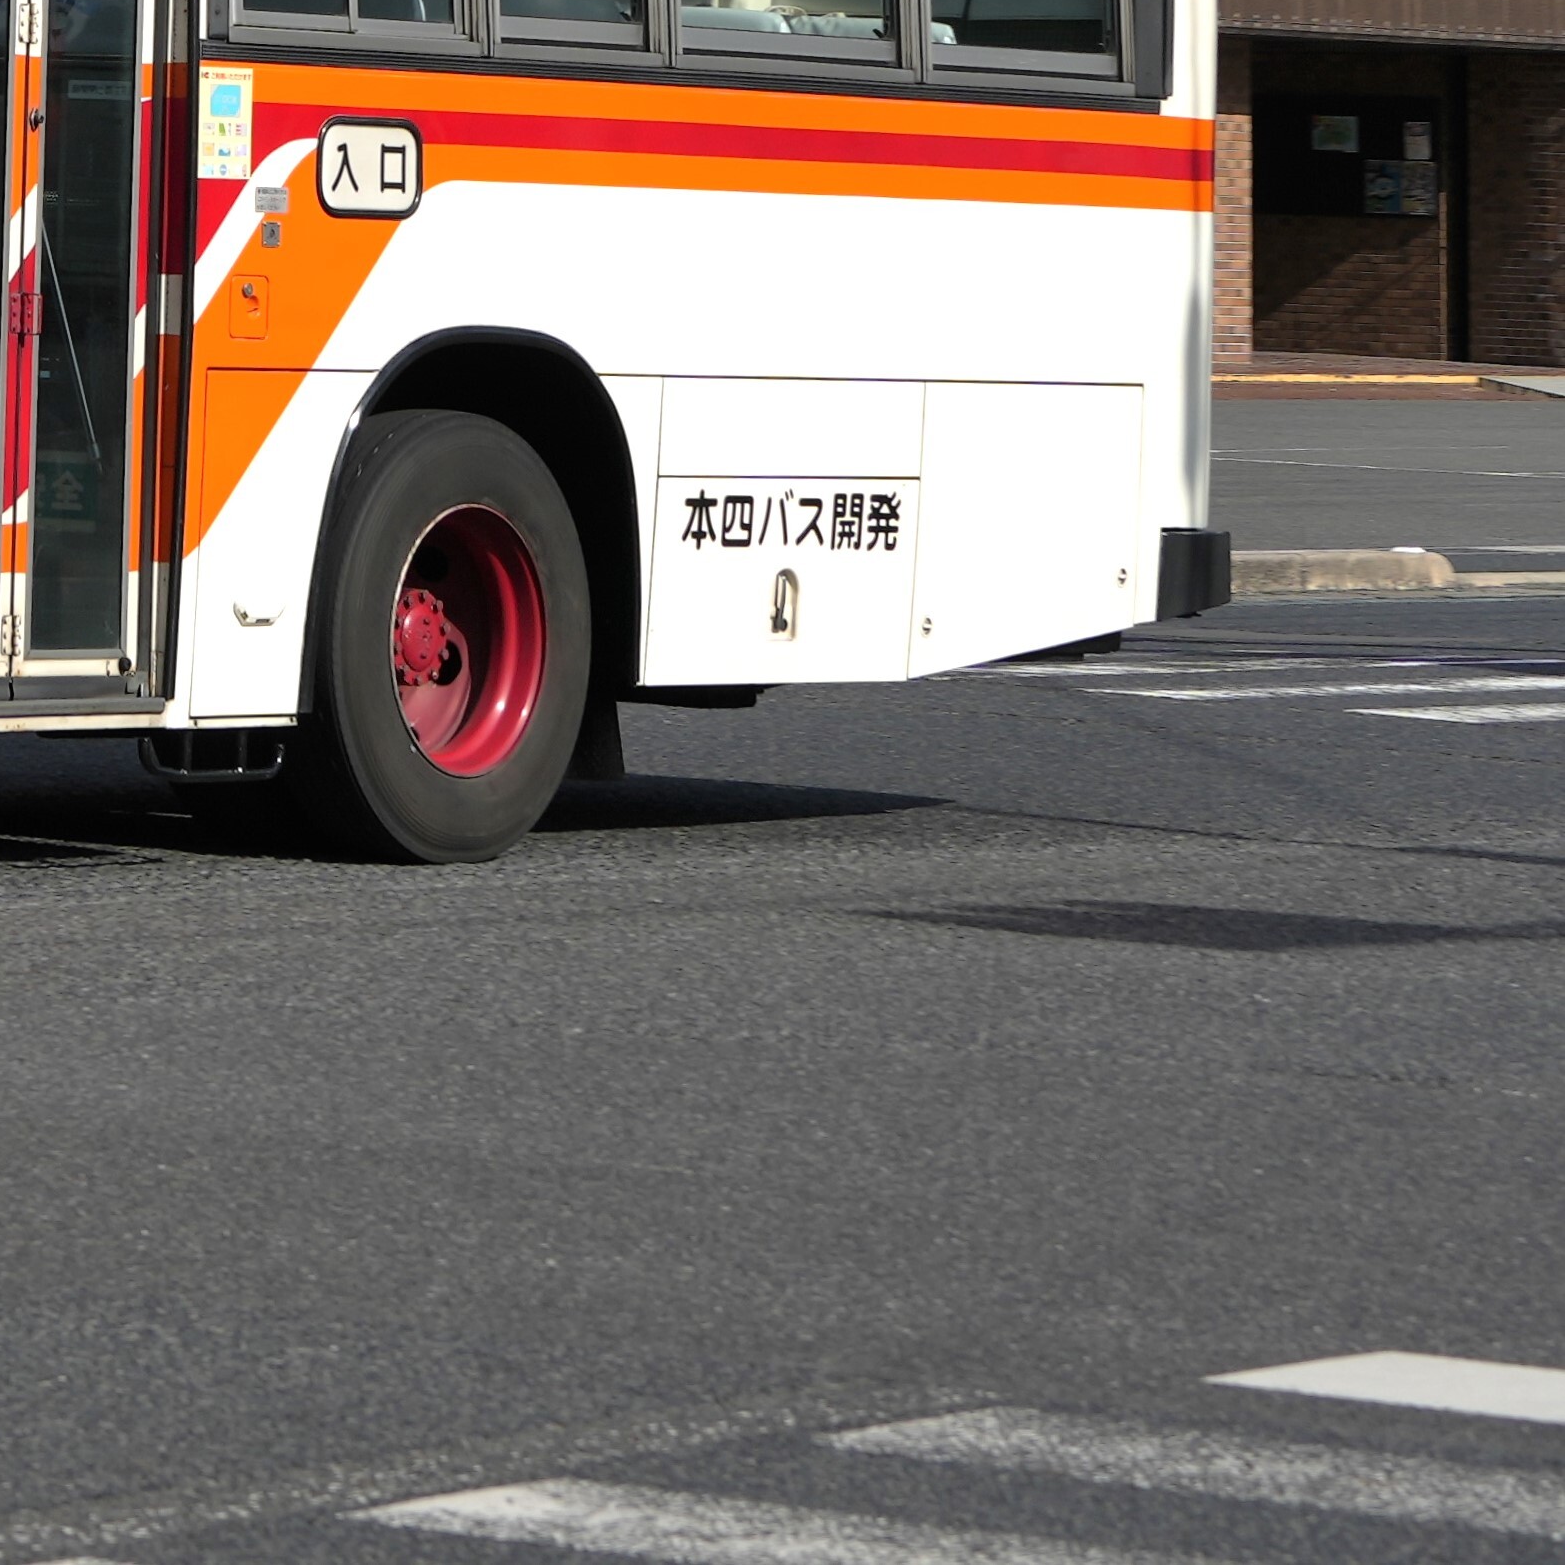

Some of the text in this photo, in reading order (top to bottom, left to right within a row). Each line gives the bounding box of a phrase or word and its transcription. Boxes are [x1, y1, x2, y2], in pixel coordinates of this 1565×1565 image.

[331, 142, 406, 194] 入口
[682, 489, 901, 551] 本四バス開発
